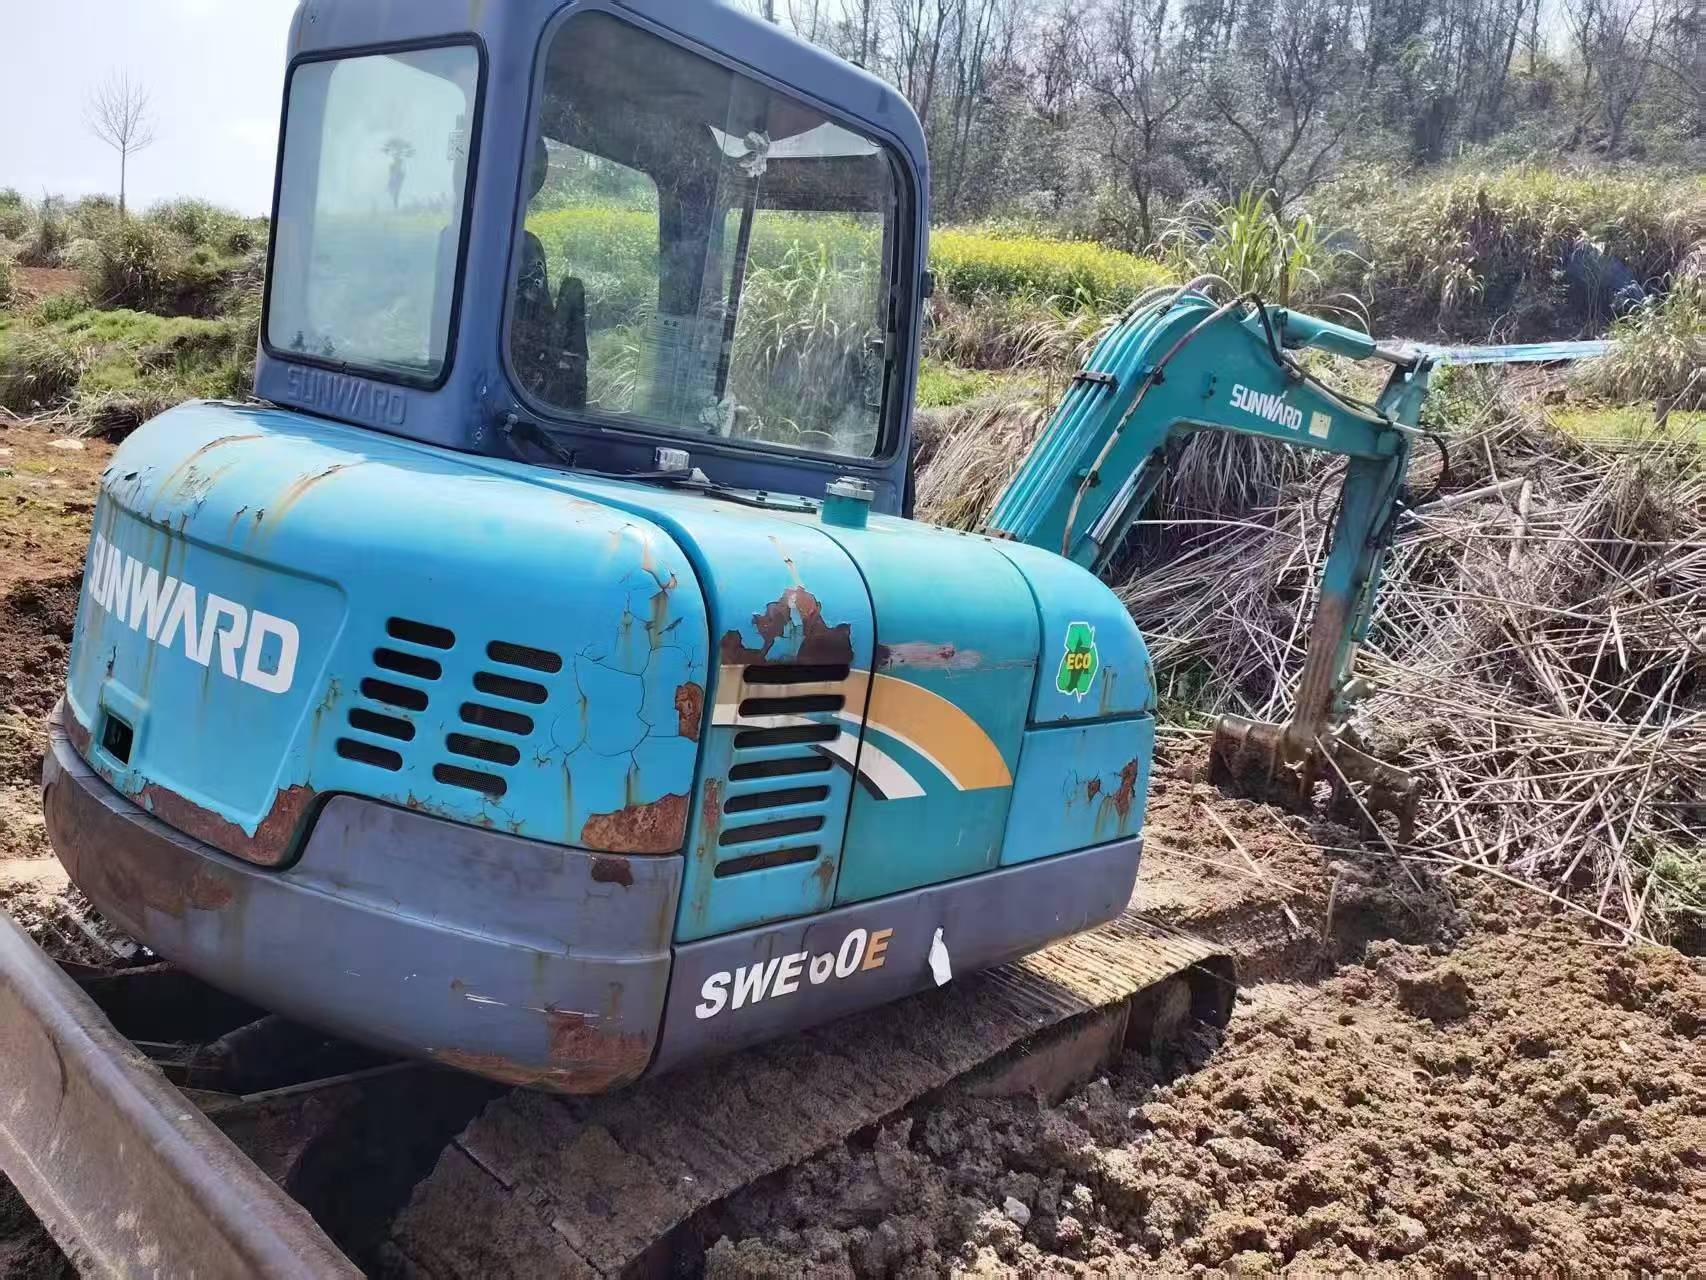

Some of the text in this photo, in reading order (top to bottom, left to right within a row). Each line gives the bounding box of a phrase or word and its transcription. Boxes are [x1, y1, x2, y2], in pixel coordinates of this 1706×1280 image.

[1229, 383, 1303, 430] SUNWARD
[88, 531, 299, 694] SUNWARD
[1066, 652, 1092, 669] ECO
